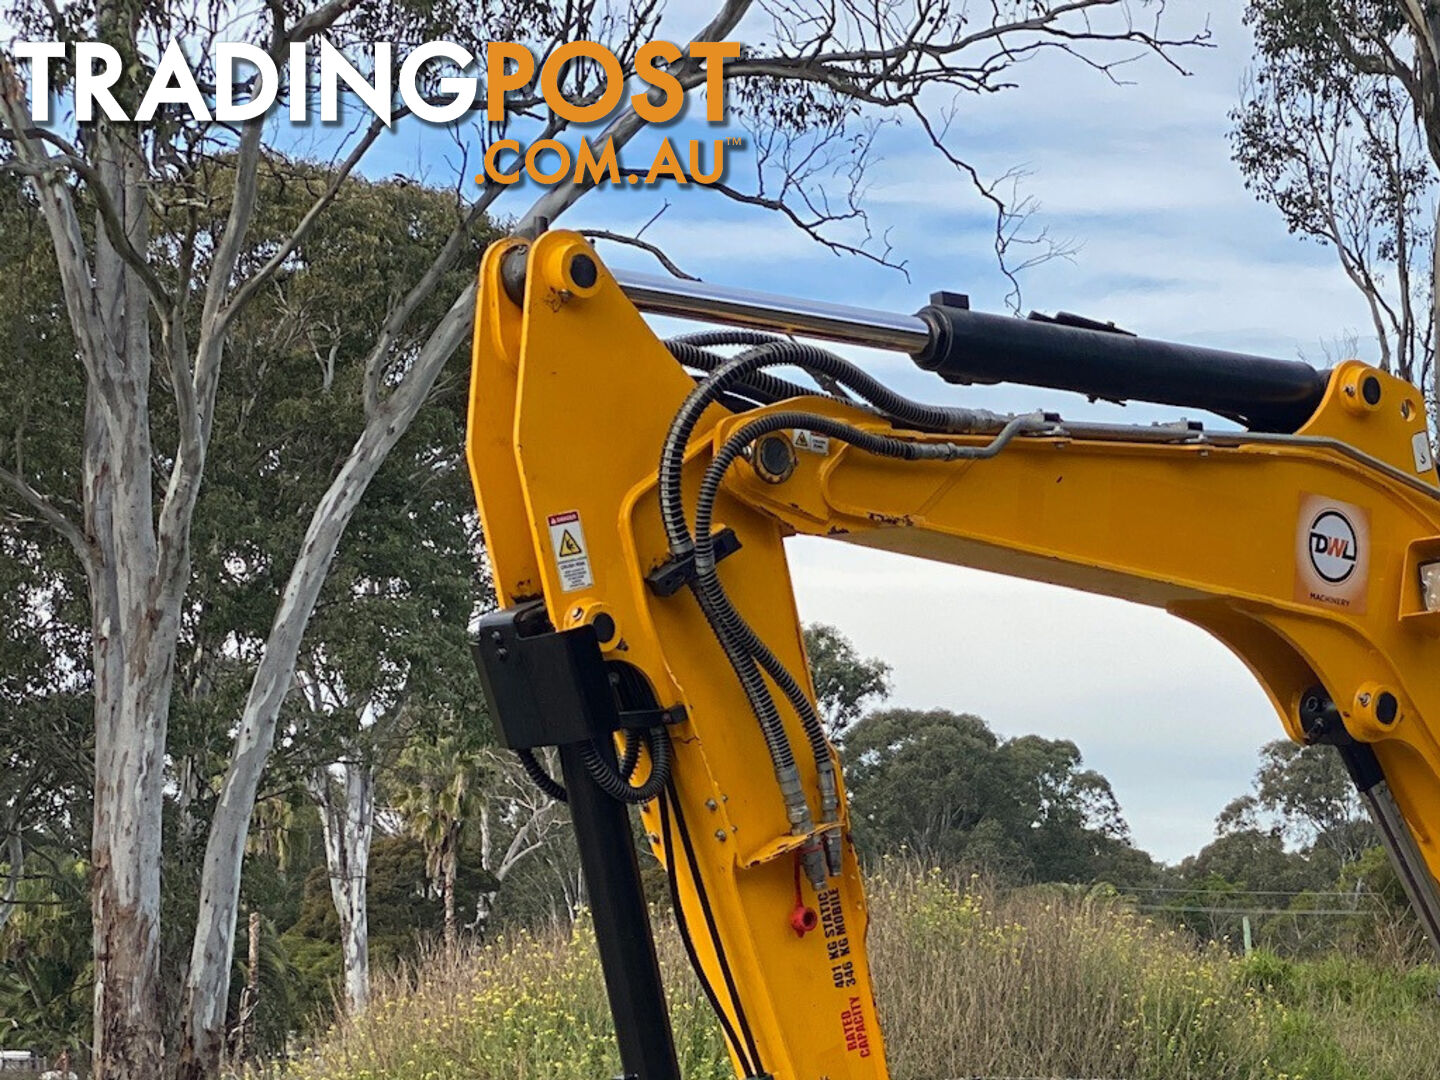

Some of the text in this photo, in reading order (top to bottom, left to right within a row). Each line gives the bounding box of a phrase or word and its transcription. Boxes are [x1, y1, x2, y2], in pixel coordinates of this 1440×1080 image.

[817, 892, 845, 988] 401 KG STATIC
[828, 887, 856, 988] 346 KG MOBILE
[841, 1010, 857, 1051] RATED
[849, 996, 870, 1058] CAPACITY
